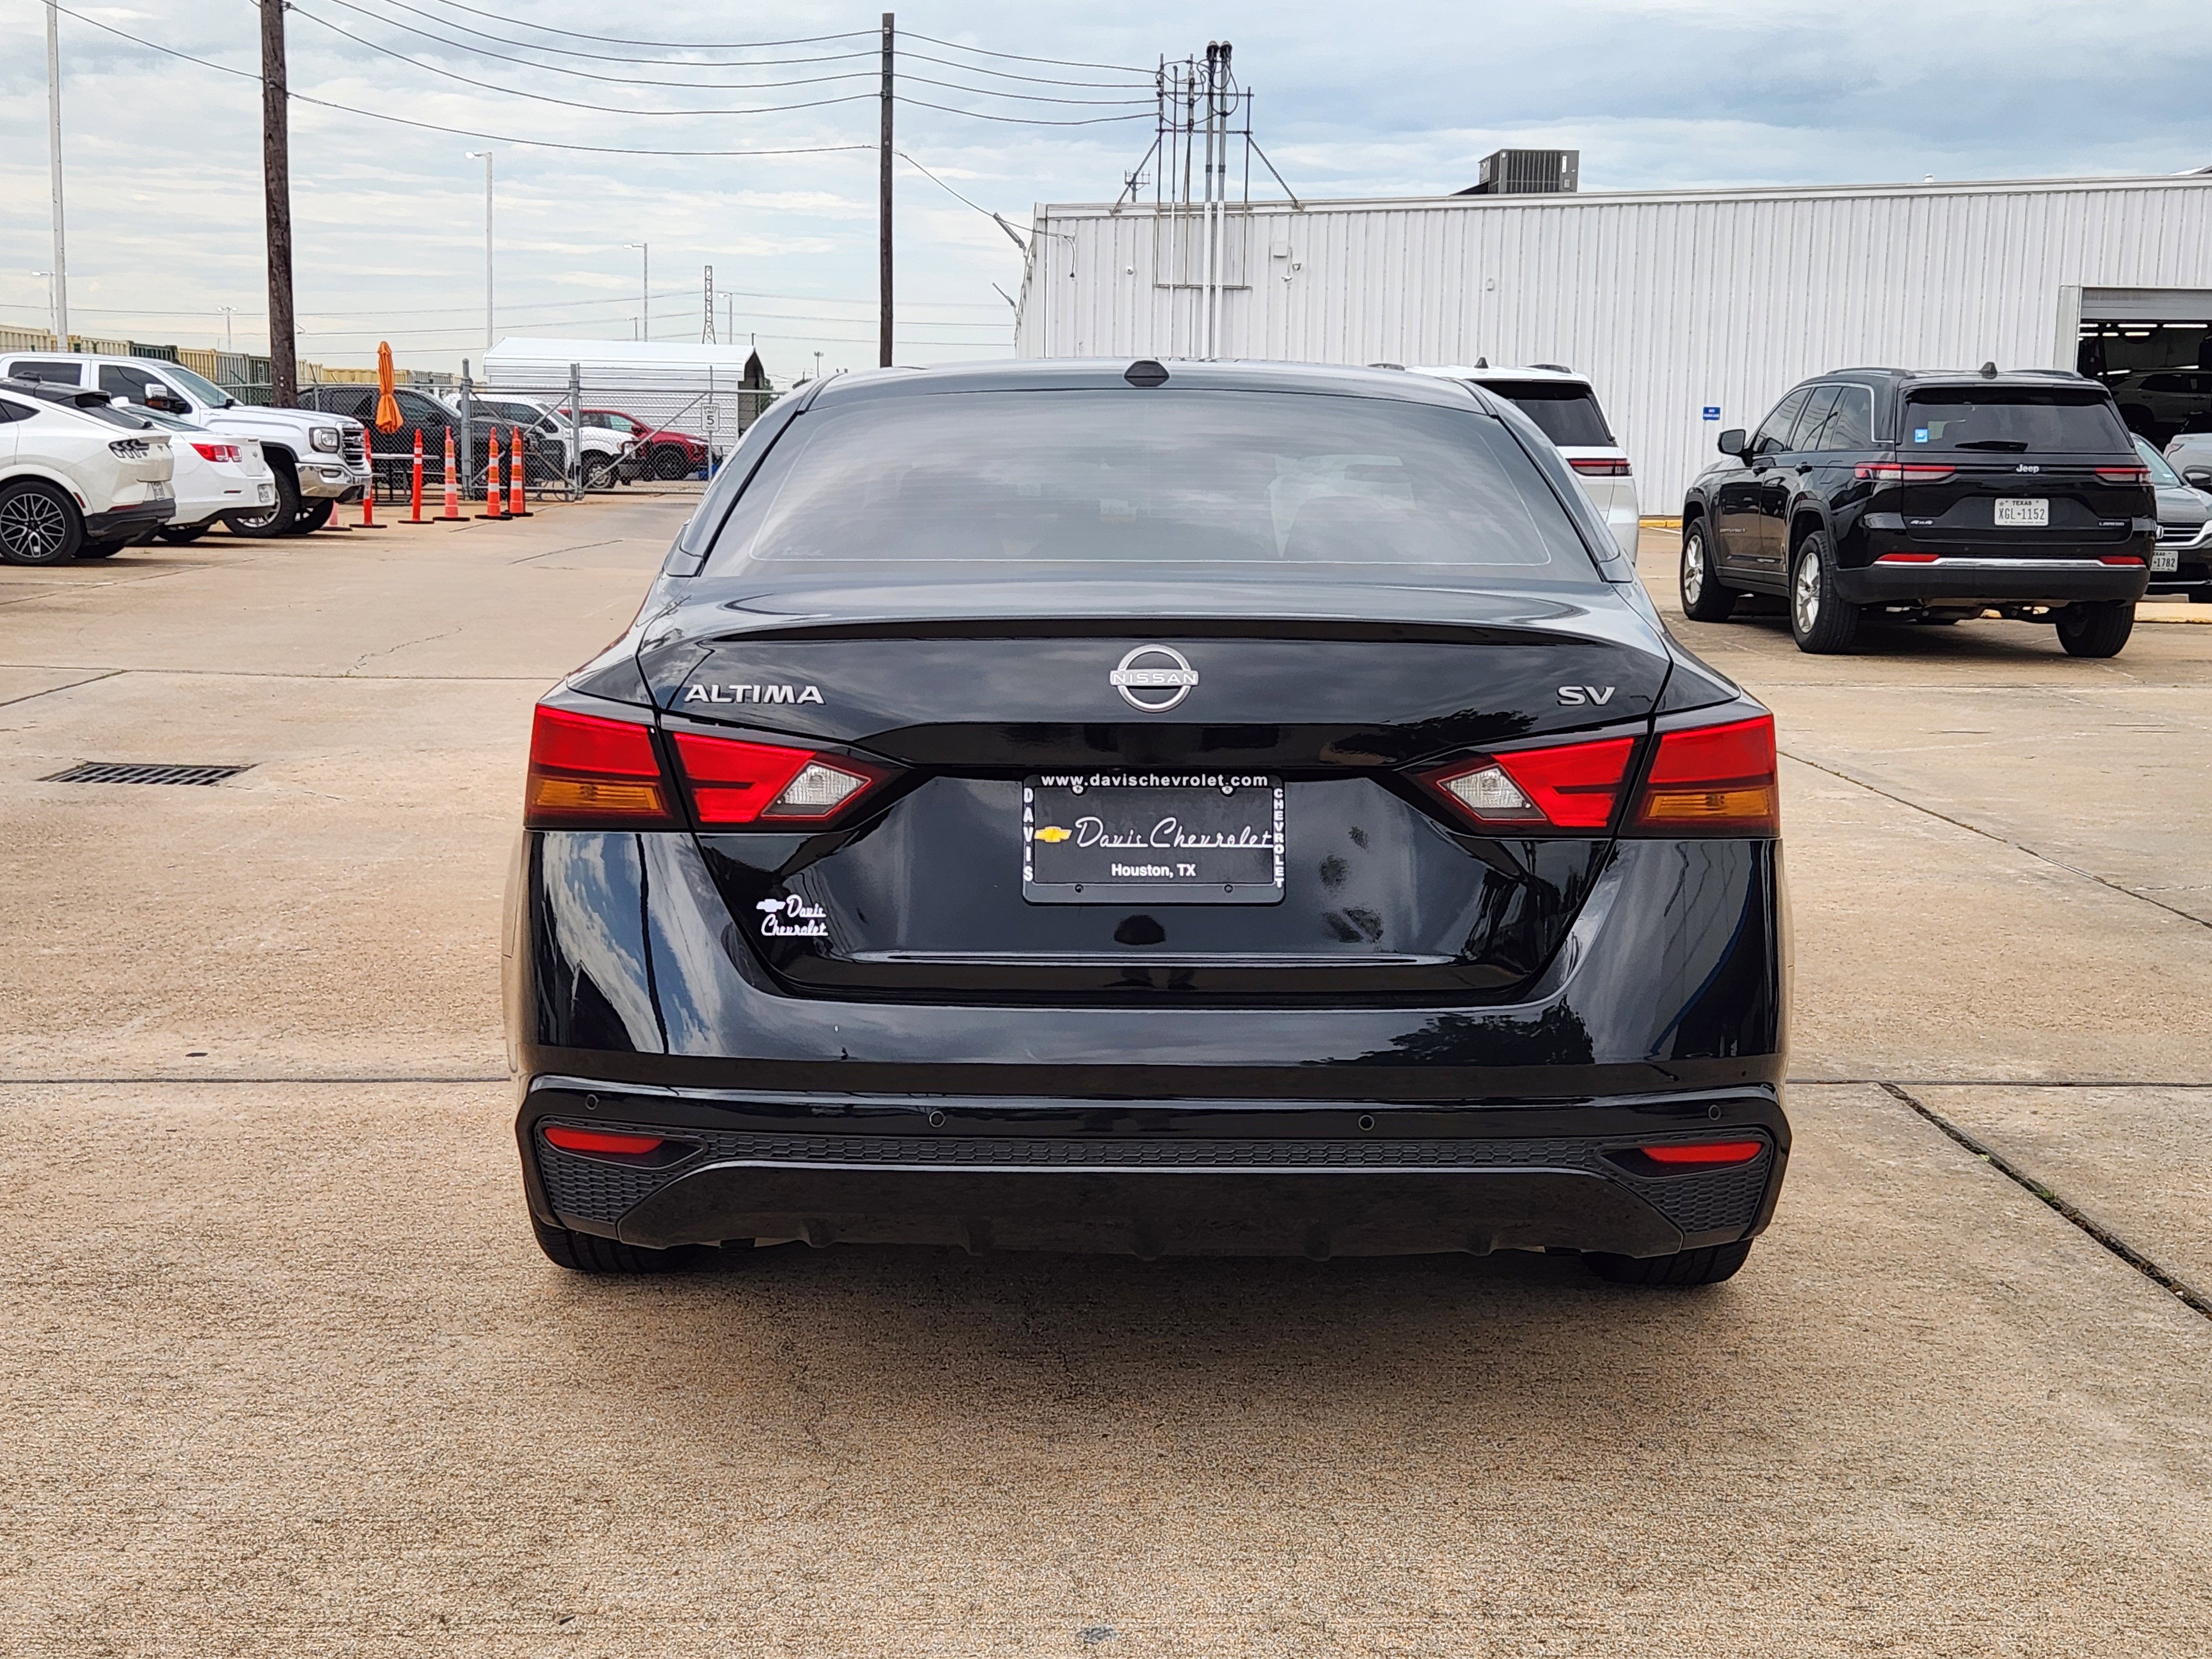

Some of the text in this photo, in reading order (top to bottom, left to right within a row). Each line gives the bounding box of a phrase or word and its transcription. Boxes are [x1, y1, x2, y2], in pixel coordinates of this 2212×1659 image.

[707, 415, 714, 425] 5
[2016, 463, 2040, 473] Jeep
[1113, 672, 1197, 684] NISSAN
[684, 684, 826, 705] ALTIMA
[1557, 686, 1616, 706] SV
[1041, 774, 1269, 787] www.davischevrolet.com
[1023, 787, 1034, 882] DAVIS
[1074, 816, 1274, 849] Davis Chevrolet
[1274, 788, 1285, 888] CHEVROLET
[1111, 863, 1197, 879] Houston, TX
[786, 894, 827, 918] Davis
[761, 914, 829, 936] Chevrolet
